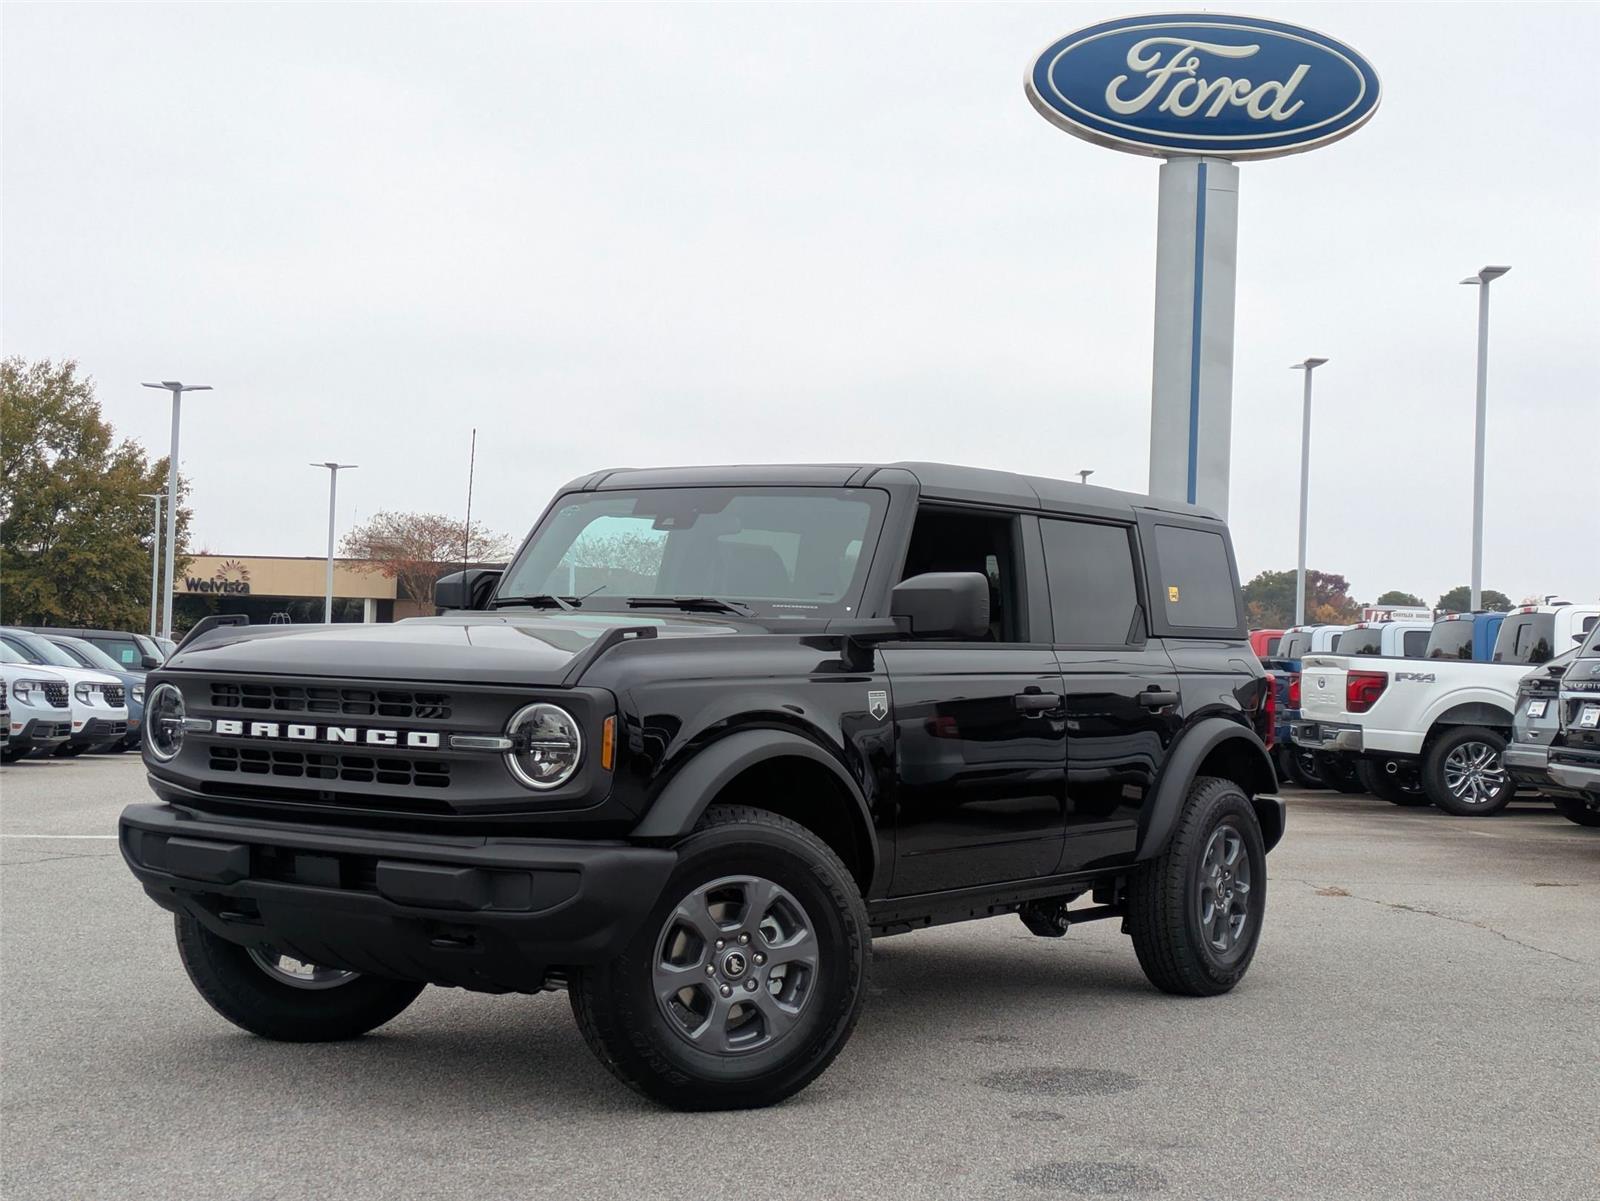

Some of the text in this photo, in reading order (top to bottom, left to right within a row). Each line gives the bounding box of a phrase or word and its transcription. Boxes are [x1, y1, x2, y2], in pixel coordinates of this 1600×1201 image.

[1105, 37, 1311, 121] Ford
[185, 577, 250, 593] Welvista
[1394, 672, 1436, 683] FX4
[215, 719, 440, 748] BRONCO
